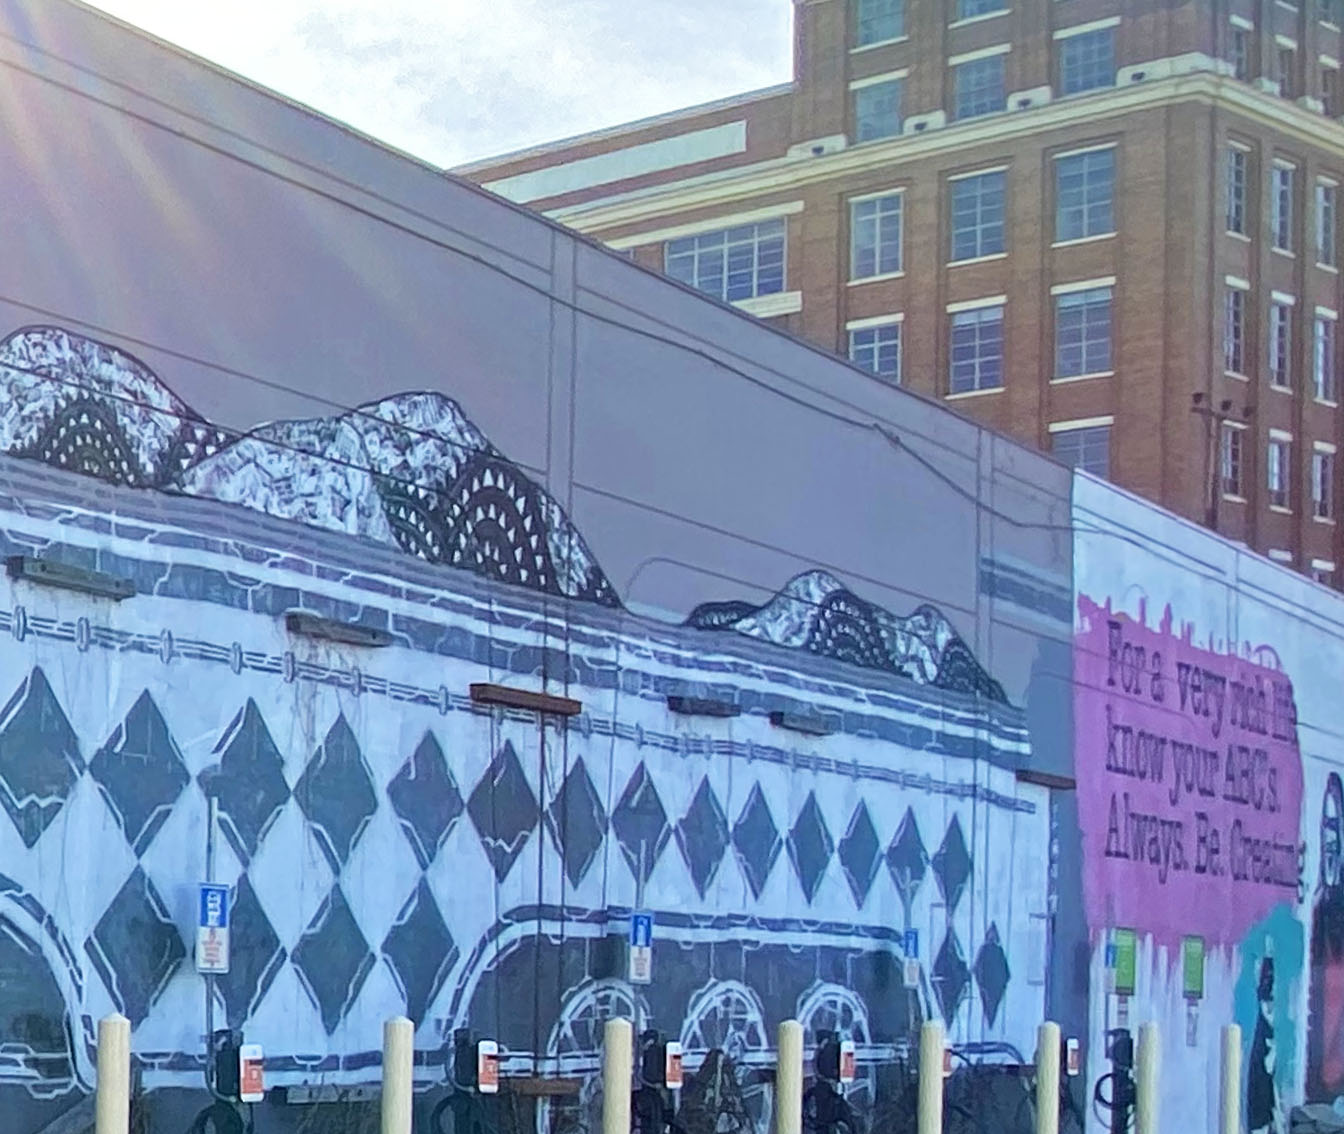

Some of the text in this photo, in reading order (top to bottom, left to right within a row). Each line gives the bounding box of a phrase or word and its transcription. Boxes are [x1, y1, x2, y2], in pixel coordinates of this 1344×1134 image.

[1107, 620, 1146, 695] For
[1150, 651, 1163, 702] a
[1177, 662, 1226, 739] very
[1105, 704, 1167, 783] know
[1169, 740, 1220, 806] your
[1105, 791, 1189, 885] Always.
[1195, 811, 1224, 877] Be.
